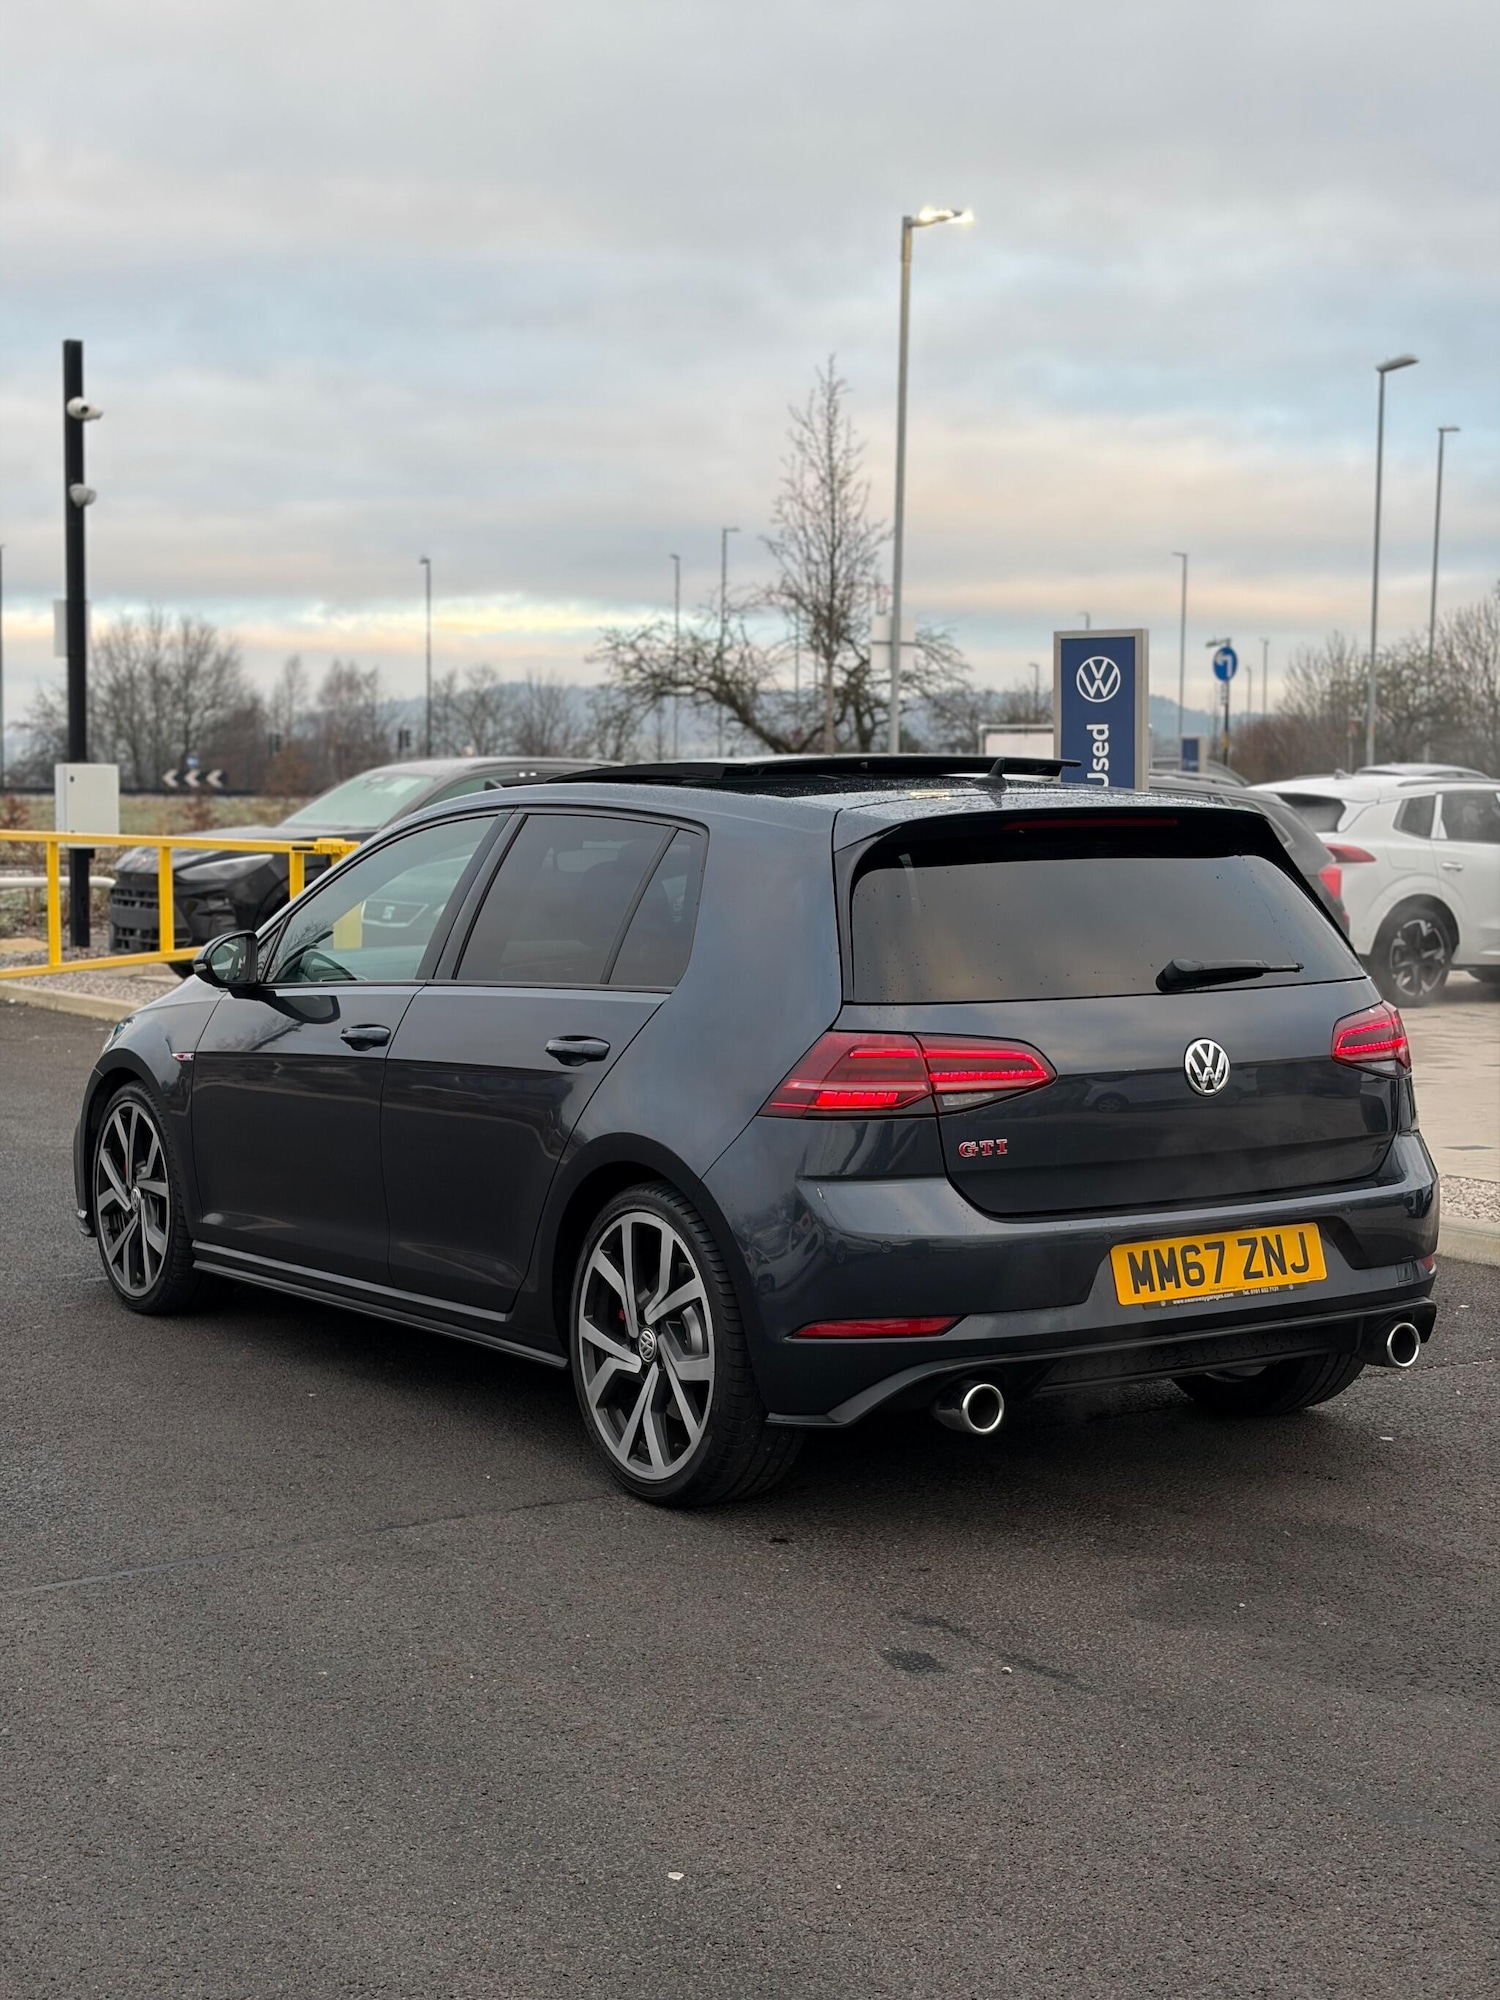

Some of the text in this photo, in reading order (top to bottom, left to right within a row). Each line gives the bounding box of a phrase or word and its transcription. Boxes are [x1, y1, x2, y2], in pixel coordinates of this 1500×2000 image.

[1076, 656, 1121, 702] VW
[1184, 1038, 1230, 1096] VW
[958, 1138, 1008, 1158] GTI
[1127, 1231, 1311, 1295] MM67 ZNJ
